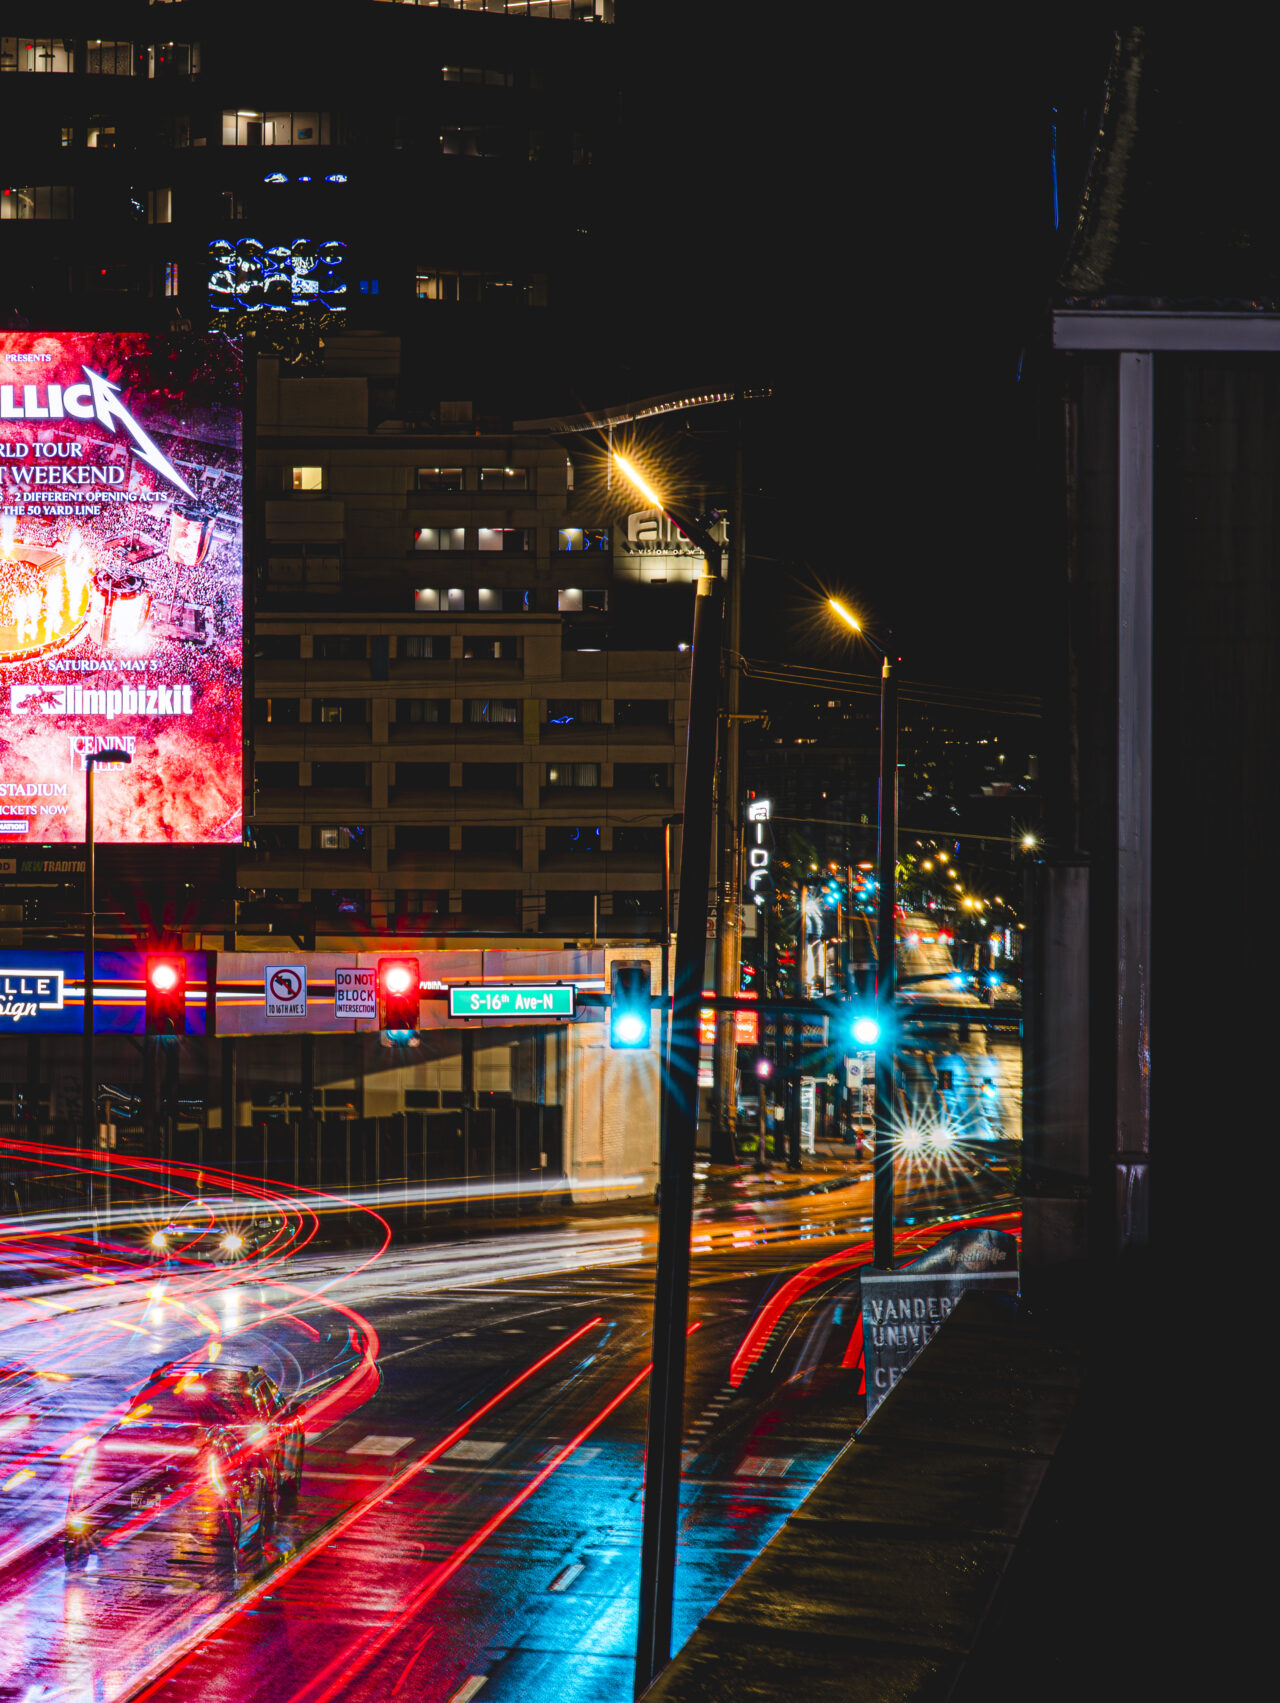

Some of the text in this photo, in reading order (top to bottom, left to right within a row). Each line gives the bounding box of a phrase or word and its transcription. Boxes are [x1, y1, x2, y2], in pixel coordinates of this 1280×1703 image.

[5, 353, 52, 363] PRESENTS
[32, 443, 83, 458] TOUR
[11, 466, 125, 485] WEEKEND
[14, 491, 21, 502] 2
[23, 491, 84, 502] DIFFERENT
[85, 491, 137, 502] OPENING
[138, 491, 168, 502] ACTS
[3, 505, 25, 516] THE
[27, 505, 41, 516] 50
[42, 505, 73, 516] YARD
[75, 505, 101, 516] LINE
[48, 659, 158, 672] SATURDAY, MAY 3
[66, 685, 193, 719] limpbizkit
[39, 805, 69, 816] NOW
[337, 973, 375, 986] DO NOT
[337, 989, 374, 1002] BLOCK
[470, 993, 554, 1010] S-16th Ave-N
[268, 1004, 304, 1014] TO 16TH AVE S
[336, 1004, 375, 1014] INTERSECTION
